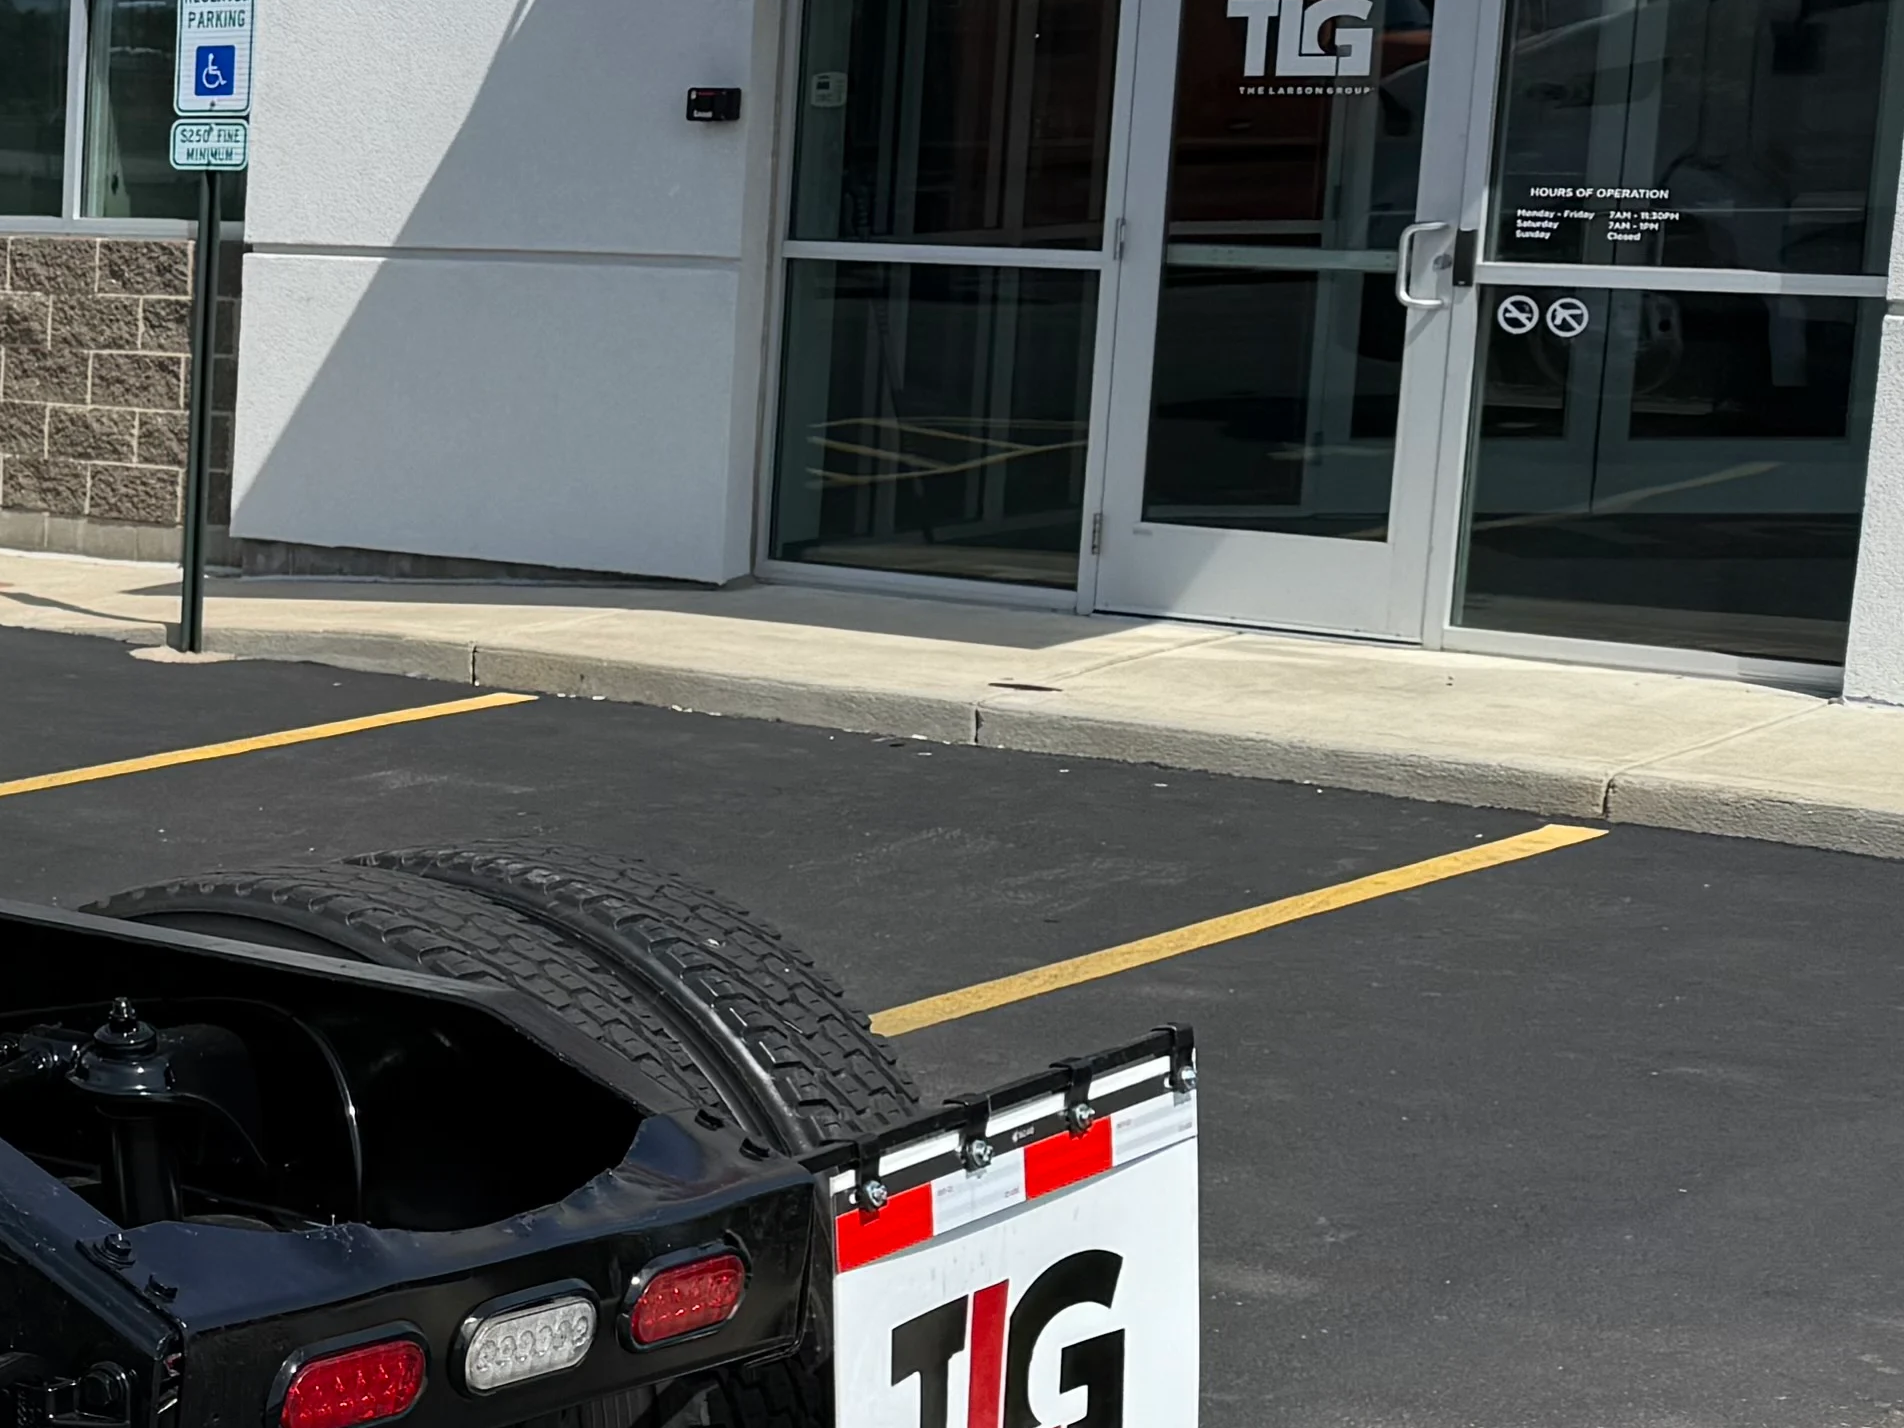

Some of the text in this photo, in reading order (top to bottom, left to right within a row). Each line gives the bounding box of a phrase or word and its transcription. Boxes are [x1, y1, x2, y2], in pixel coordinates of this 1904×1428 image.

[187, 10, 246, 29] PARKING
[1239, 85, 1265, 95] THE
[179, 128, 241, 144] $250 FINE
[1529, 187, 1670, 200] HOURS OF OPERATION
[1517, 209, 1556, 220] Monday
[1563, 210, 1596, 221] Friday
[1609, 210, 1632, 220] 7AM
[1516, 219, 1560, 230] Saturday
[1608, 221, 1631, 231] 7AM
[1515, 229, 1552, 240] Sunday
[1607, 231, 1641, 242] Closed
